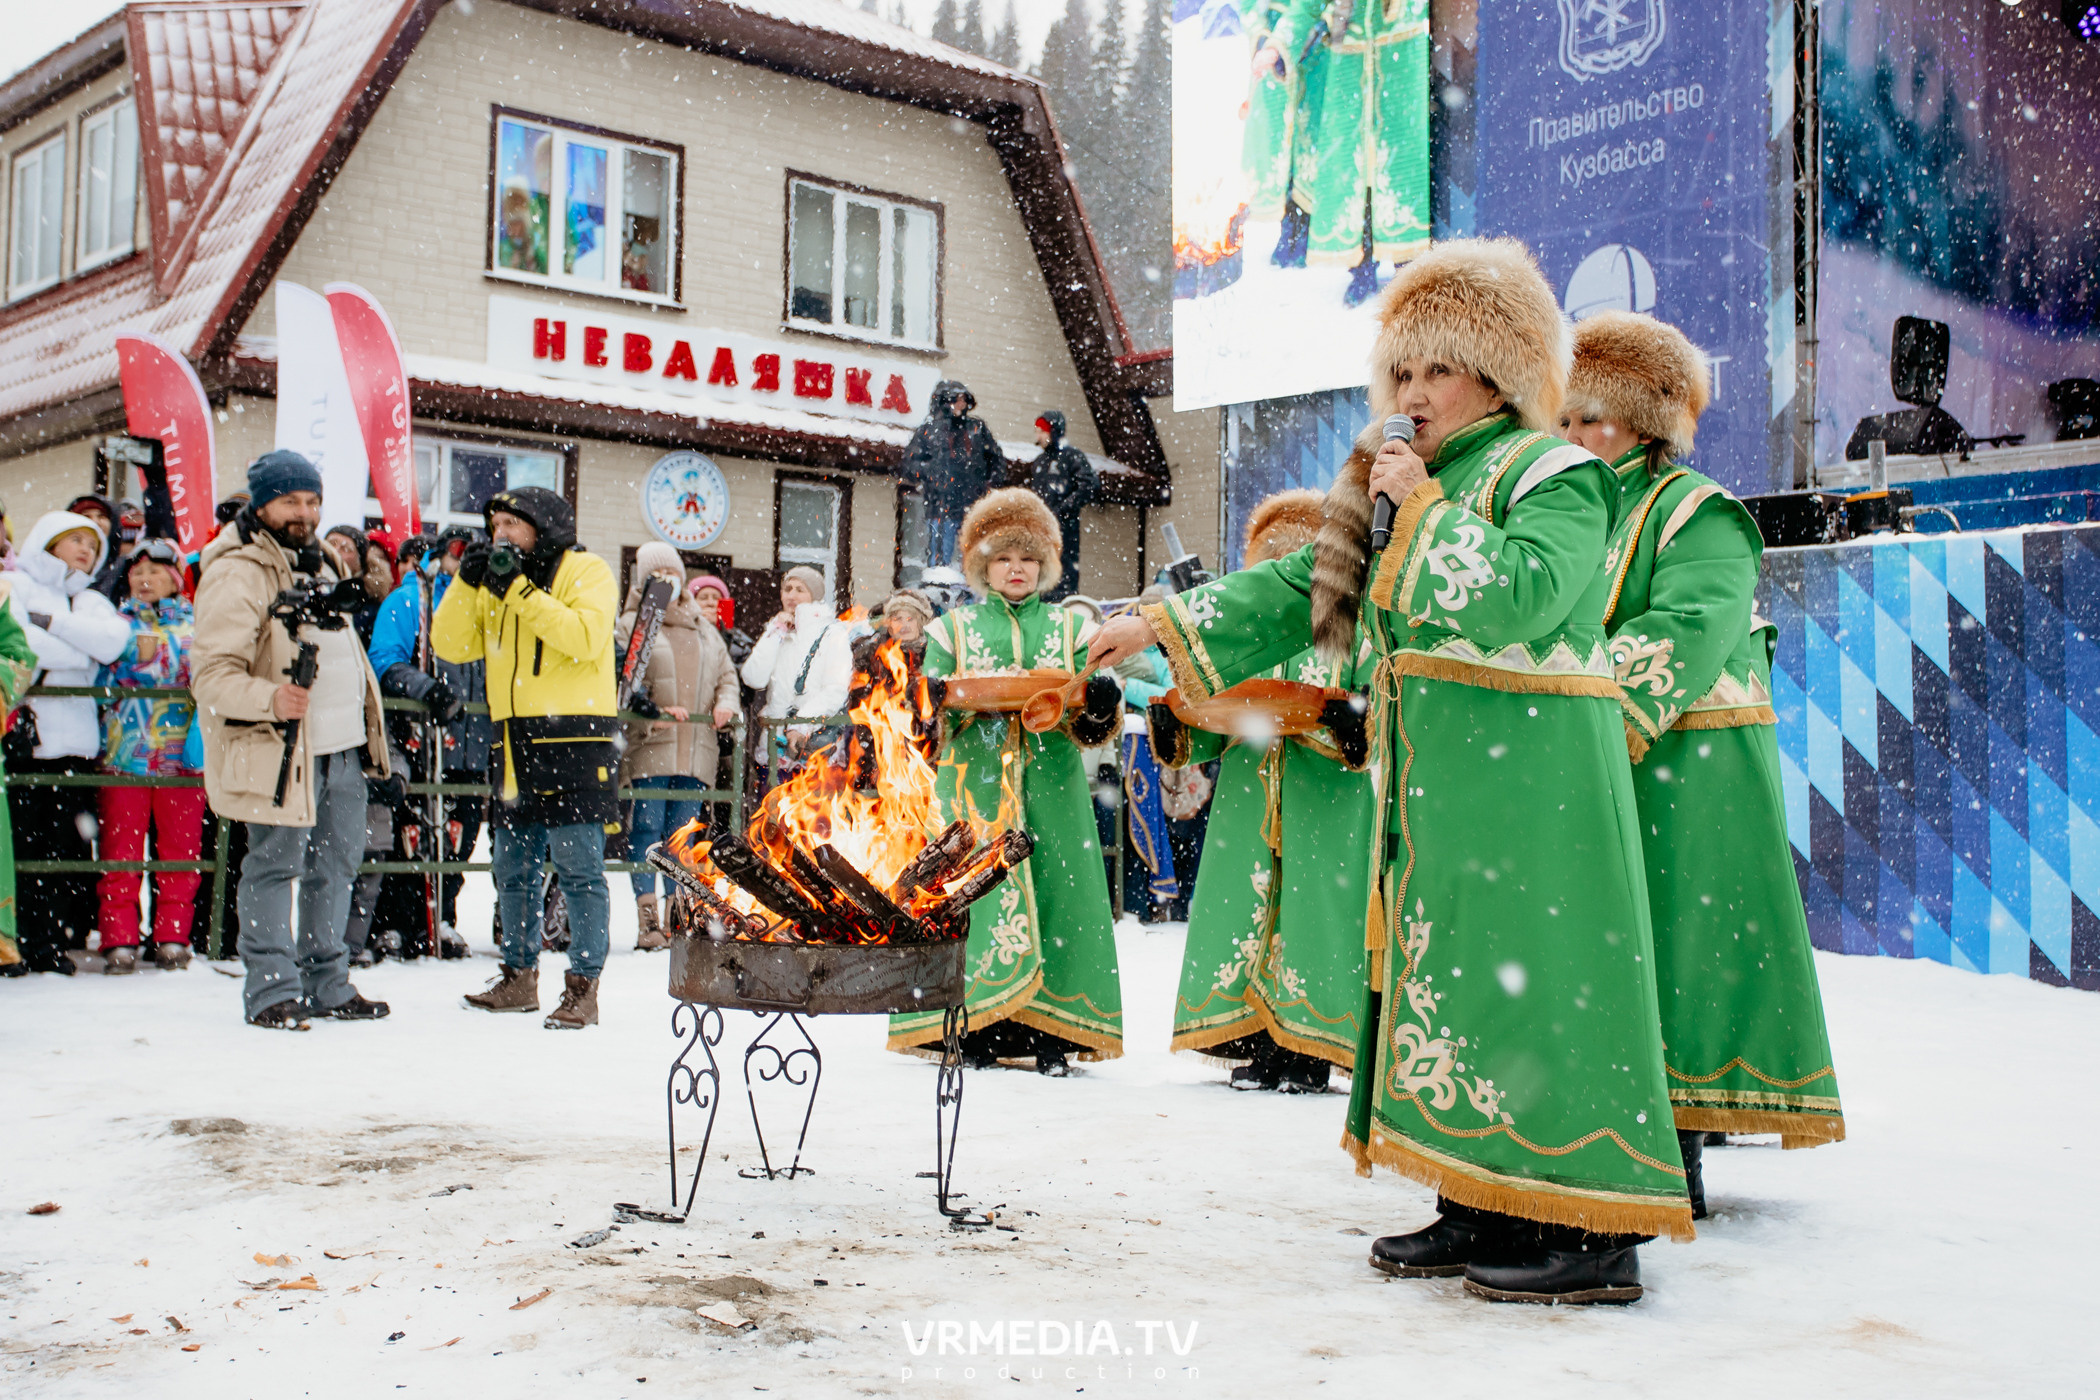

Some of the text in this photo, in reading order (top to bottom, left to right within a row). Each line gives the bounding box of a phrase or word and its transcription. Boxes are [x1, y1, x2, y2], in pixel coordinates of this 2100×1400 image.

[1528, 84, 1704, 150] Правительство
[1560, 137, 1666, 188] Кузбасса
[533, 318, 912, 414] НЕВАЛЯШКА
